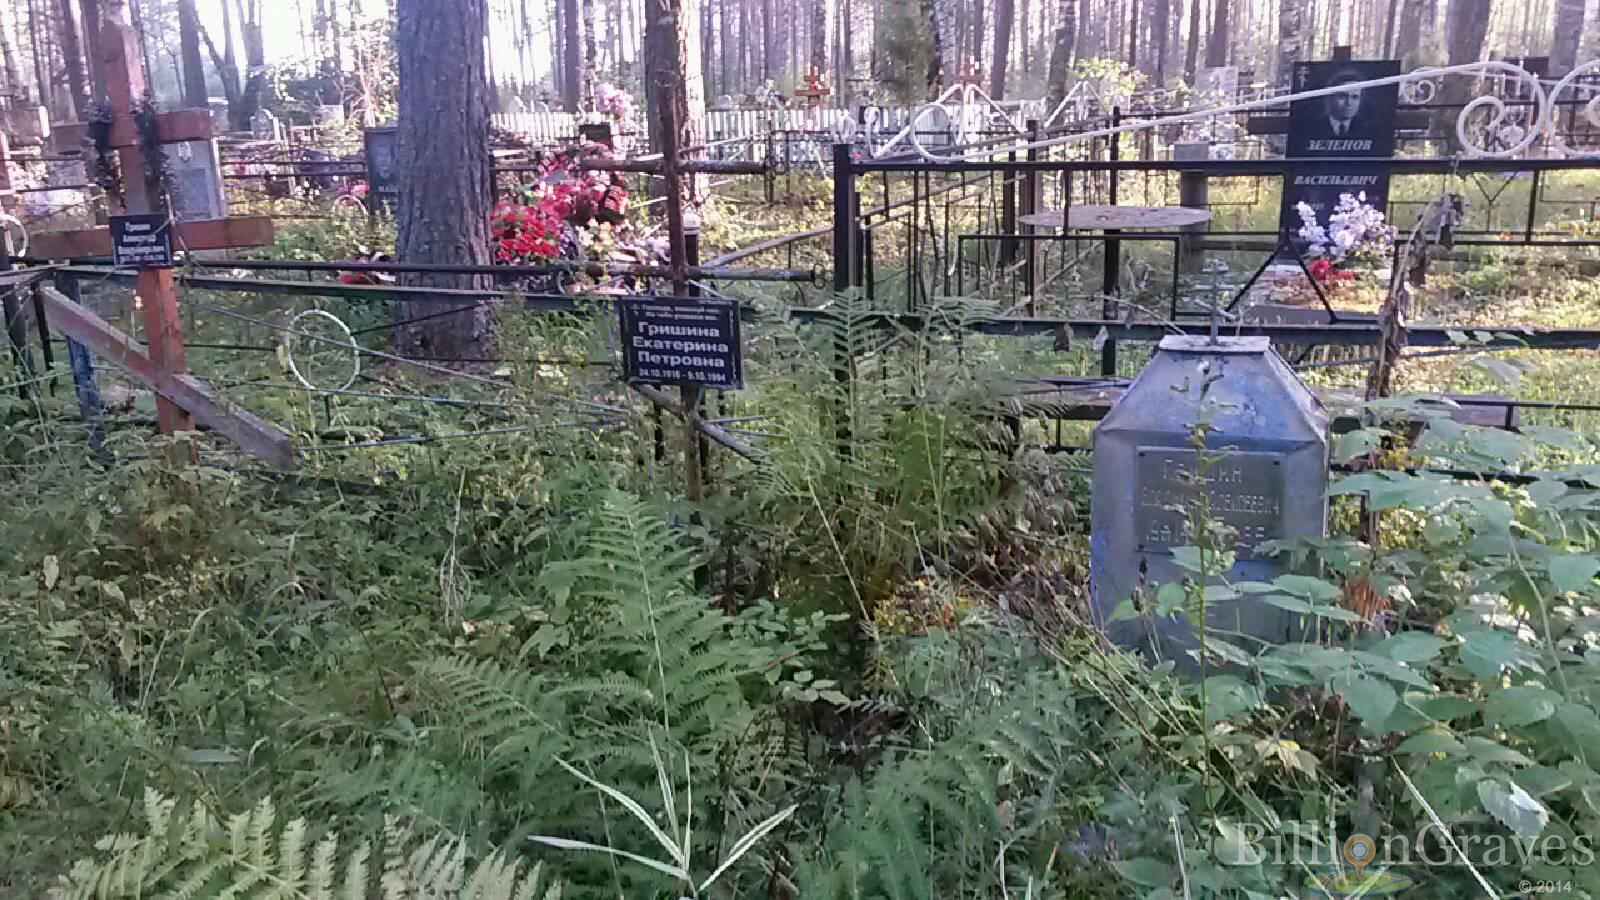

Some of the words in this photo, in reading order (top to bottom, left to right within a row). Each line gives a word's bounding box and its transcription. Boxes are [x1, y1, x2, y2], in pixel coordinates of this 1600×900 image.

[1306, 139, 1373, 151] ЗЕЛЕНОВ
[638, 321, 720, 337] Гришина
[632, 335, 729, 353] Екатерина
[638, 350, 725, 367] Петровна
